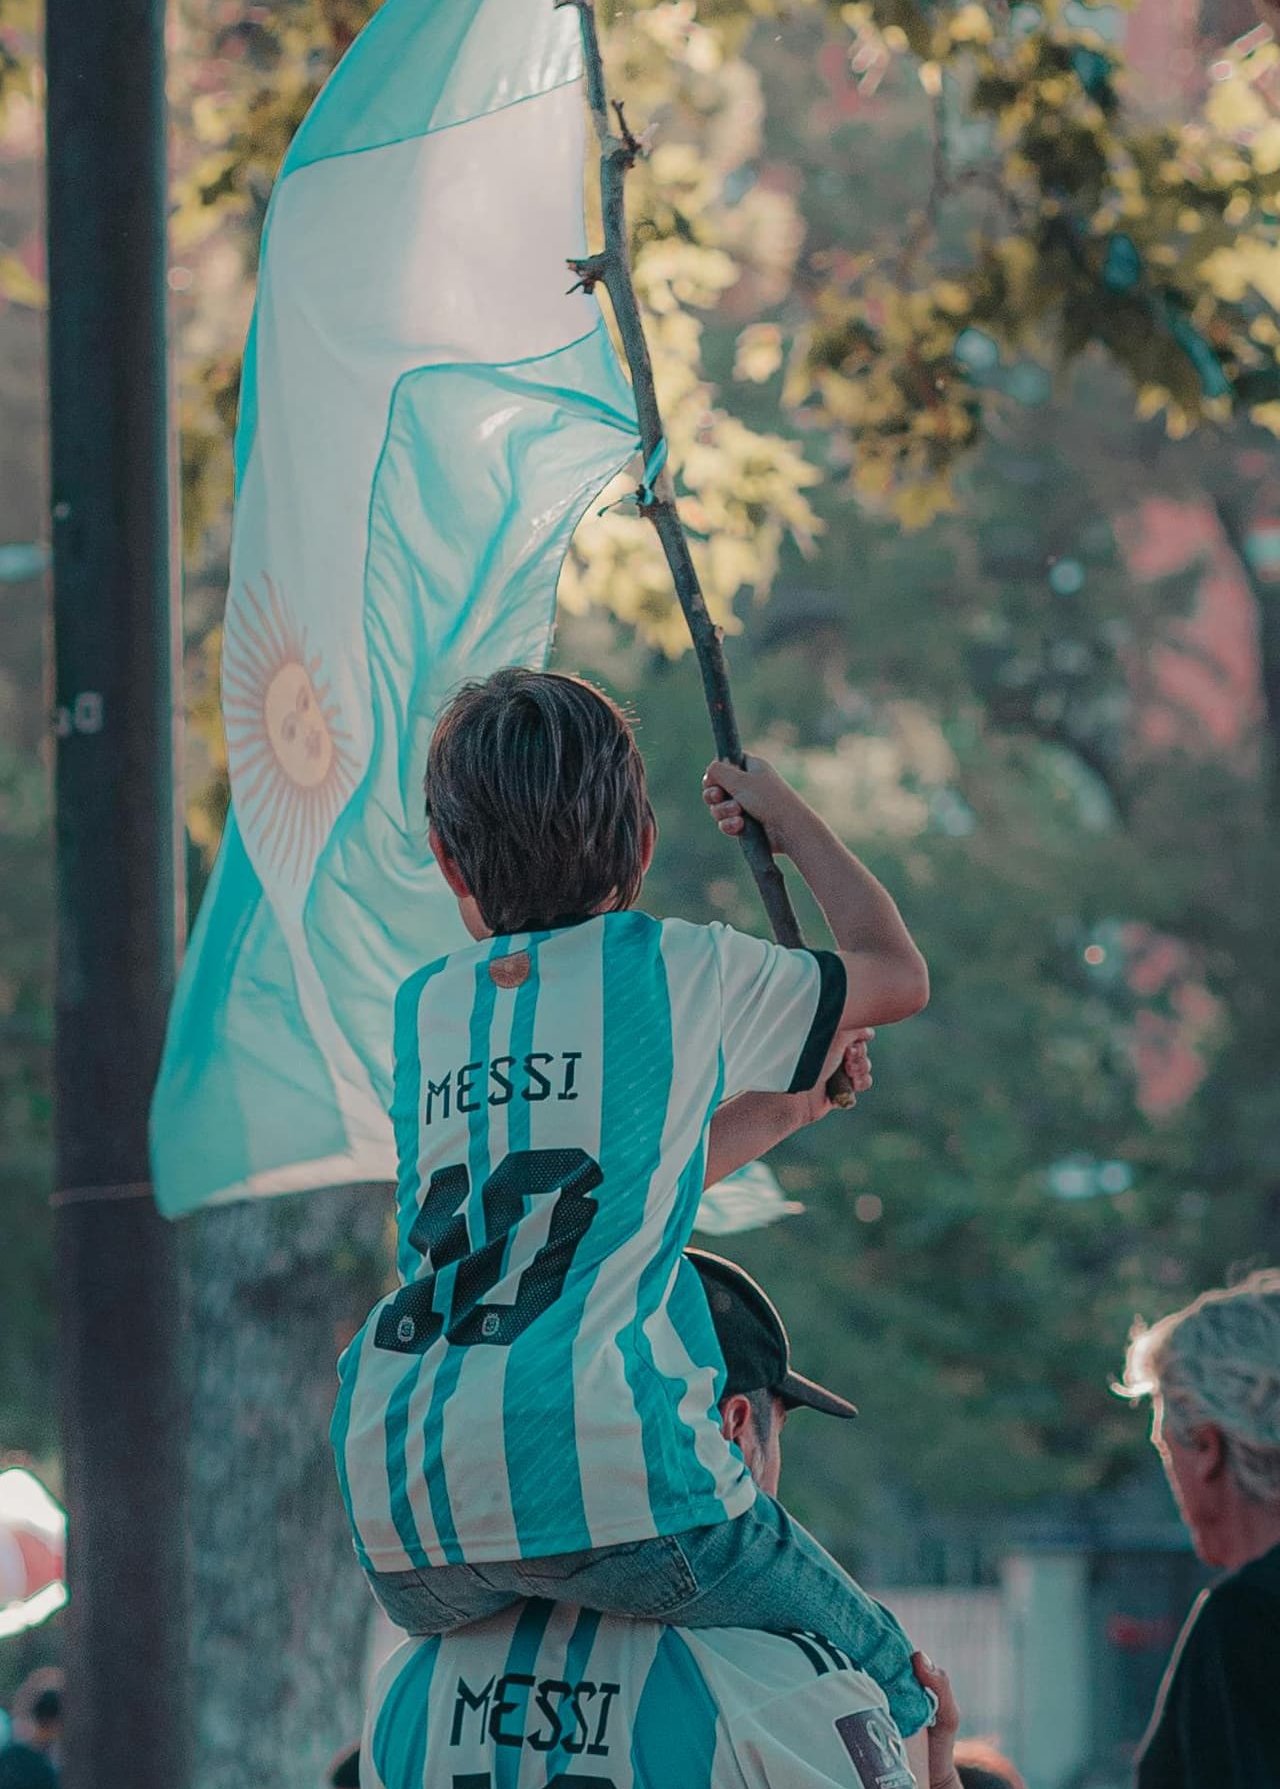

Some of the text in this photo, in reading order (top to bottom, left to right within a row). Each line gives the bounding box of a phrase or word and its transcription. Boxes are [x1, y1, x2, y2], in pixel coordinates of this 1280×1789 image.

[425, 1052, 582, 1125] MESSI
[373, 1147, 604, 1355] 10
[449, 1673, 620, 1756] MESSI
